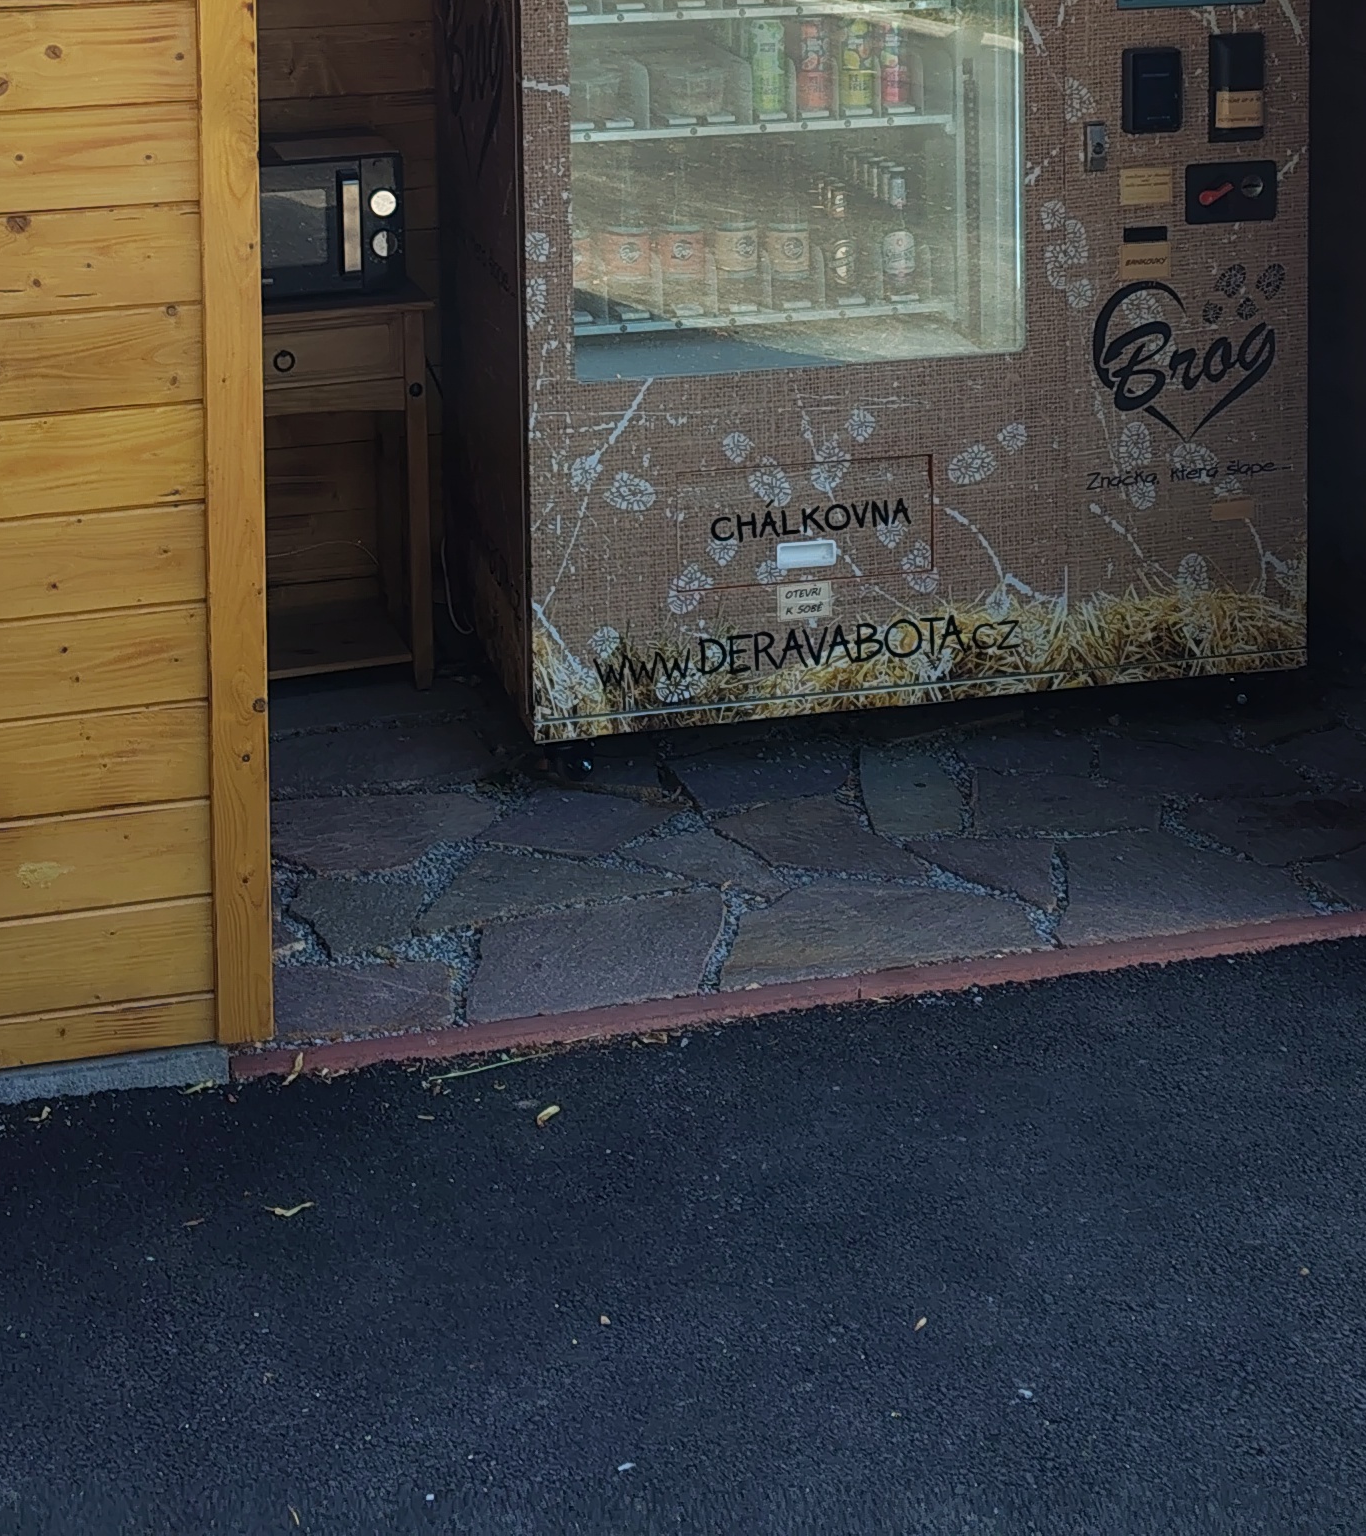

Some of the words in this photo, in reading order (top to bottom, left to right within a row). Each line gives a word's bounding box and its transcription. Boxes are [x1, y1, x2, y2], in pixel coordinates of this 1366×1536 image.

[1104, 321, 1277, 414] Brog
[710, 497, 912, 543] CHÁLKOVNA
[785, 584, 822, 600] OTEVŘI
[785, 606, 793, 615] K
[796, 601, 824, 614] SOBĚ
